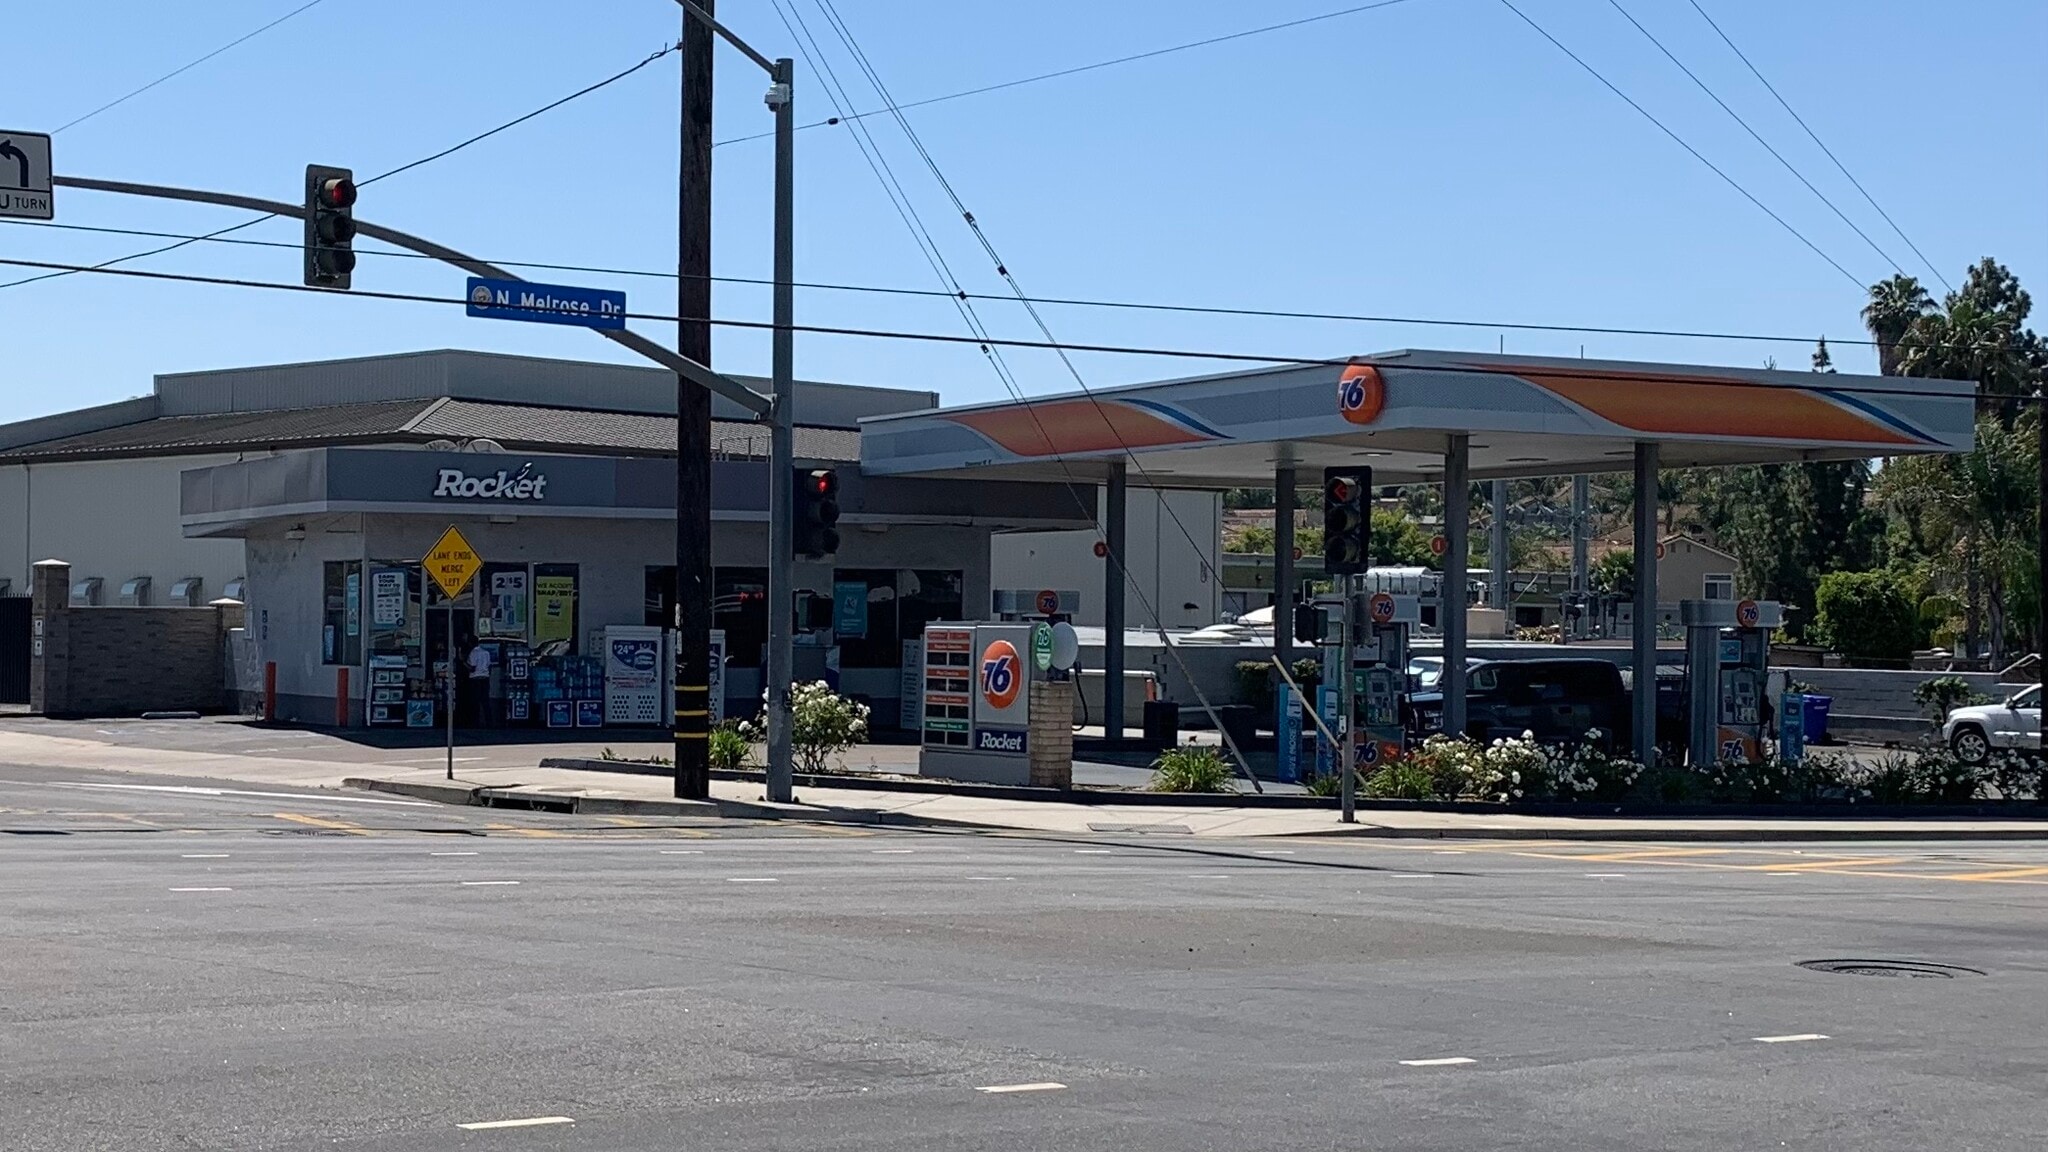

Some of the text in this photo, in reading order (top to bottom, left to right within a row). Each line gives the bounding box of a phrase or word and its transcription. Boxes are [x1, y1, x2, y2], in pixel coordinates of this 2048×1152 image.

[15, 197, 47, 210] TURN
[521, 292, 590, 316] Melrose
[600, 299, 621, 320] Dr
[1338, 375, 1366, 411] 76
[434, 464, 547, 499] Rocket
[433, 551, 471, 560] LANE ENDS
[441, 564, 464, 574] MERGE
[444, 577, 460, 587] LEFT
[1043, 596, 1056, 609] 76
[1376, 601, 1391, 615] 76
[1743, 607, 1757, 620] 76
[1038, 627, 1050, 646] 76
[982, 655, 1013, 695] 76
[980, 732, 1022, 751] Rocket
[1722, 739, 1744, 760] 76
[1354, 740, 1378, 764] 76
